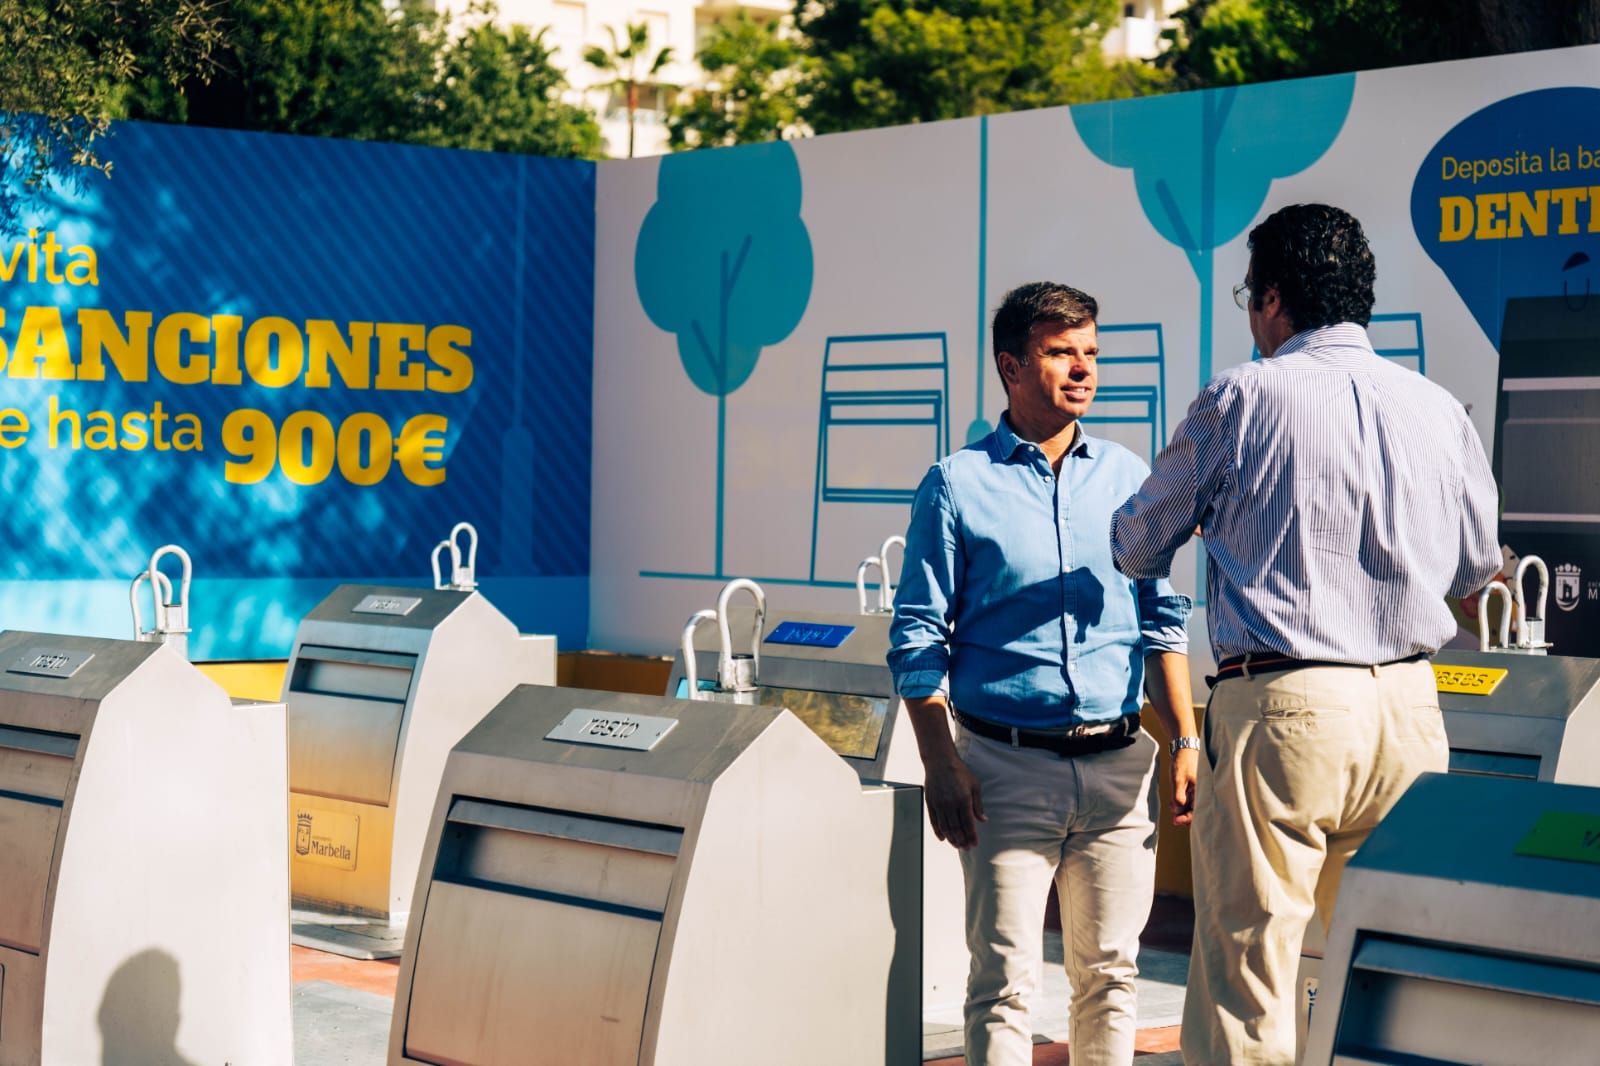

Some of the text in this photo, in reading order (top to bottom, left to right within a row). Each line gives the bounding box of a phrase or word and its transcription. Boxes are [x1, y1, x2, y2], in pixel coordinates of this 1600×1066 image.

[1441, 150, 1543, 184] Deposita
[1550, 147, 1571, 172] la
[0, 305, 474, 393] ANCIONES
[48, 395, 203, 451] hasta
[221, 408, 448, 486] 900€
[579, 717, 639, 738] resto
[311, 840, 351, 860] Marbella
